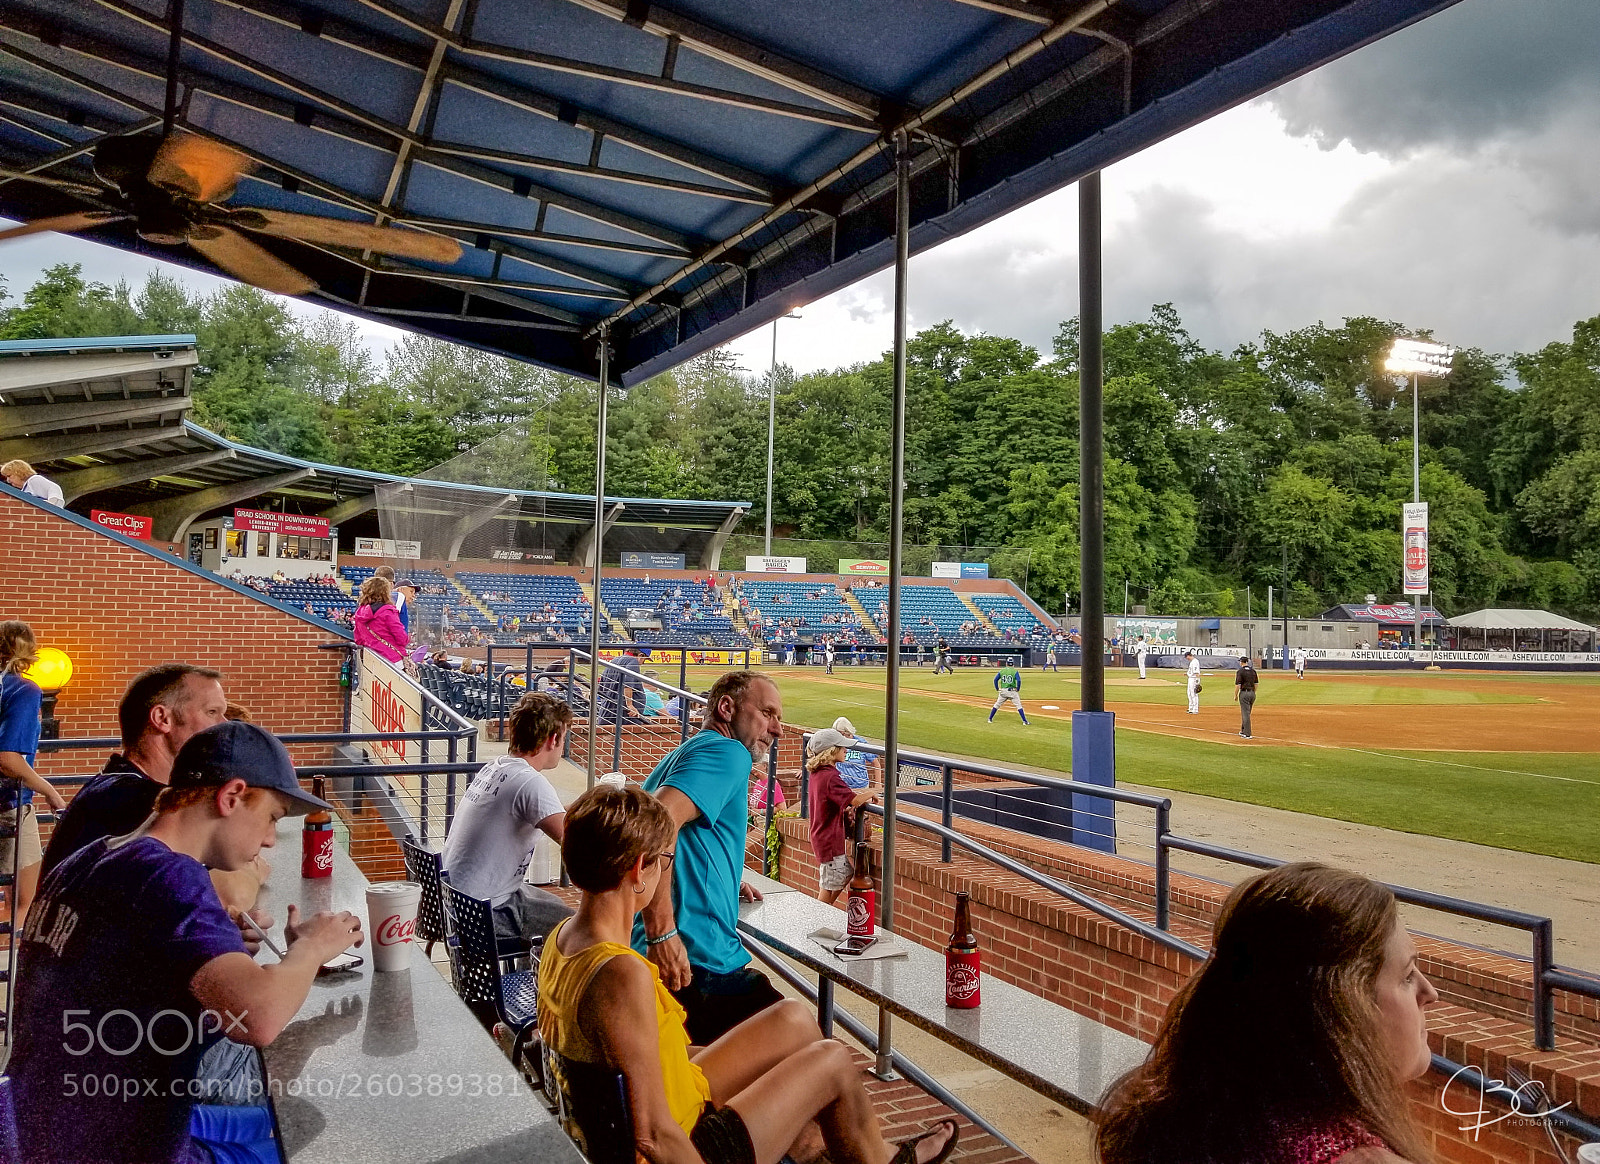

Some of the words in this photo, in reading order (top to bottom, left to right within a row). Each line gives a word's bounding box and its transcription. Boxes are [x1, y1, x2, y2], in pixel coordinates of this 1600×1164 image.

[98, 513, 123, 527] Great
[123, 516, 144, 531] Clips
[236, 510, 254, 518] GRAD
[254, 512, 277, 521] SCHOOL
[285, 516, 318, 525] DOWNTOWN
[1350, 650, 1410, 660] ASHEVILLE.COM
[1433, 652, 1490, 661] ASHEVILLE.COM
[1512, 653, 1566, 662] ASHEVILLE.COM
[376, 915, 418, 947] Coca
